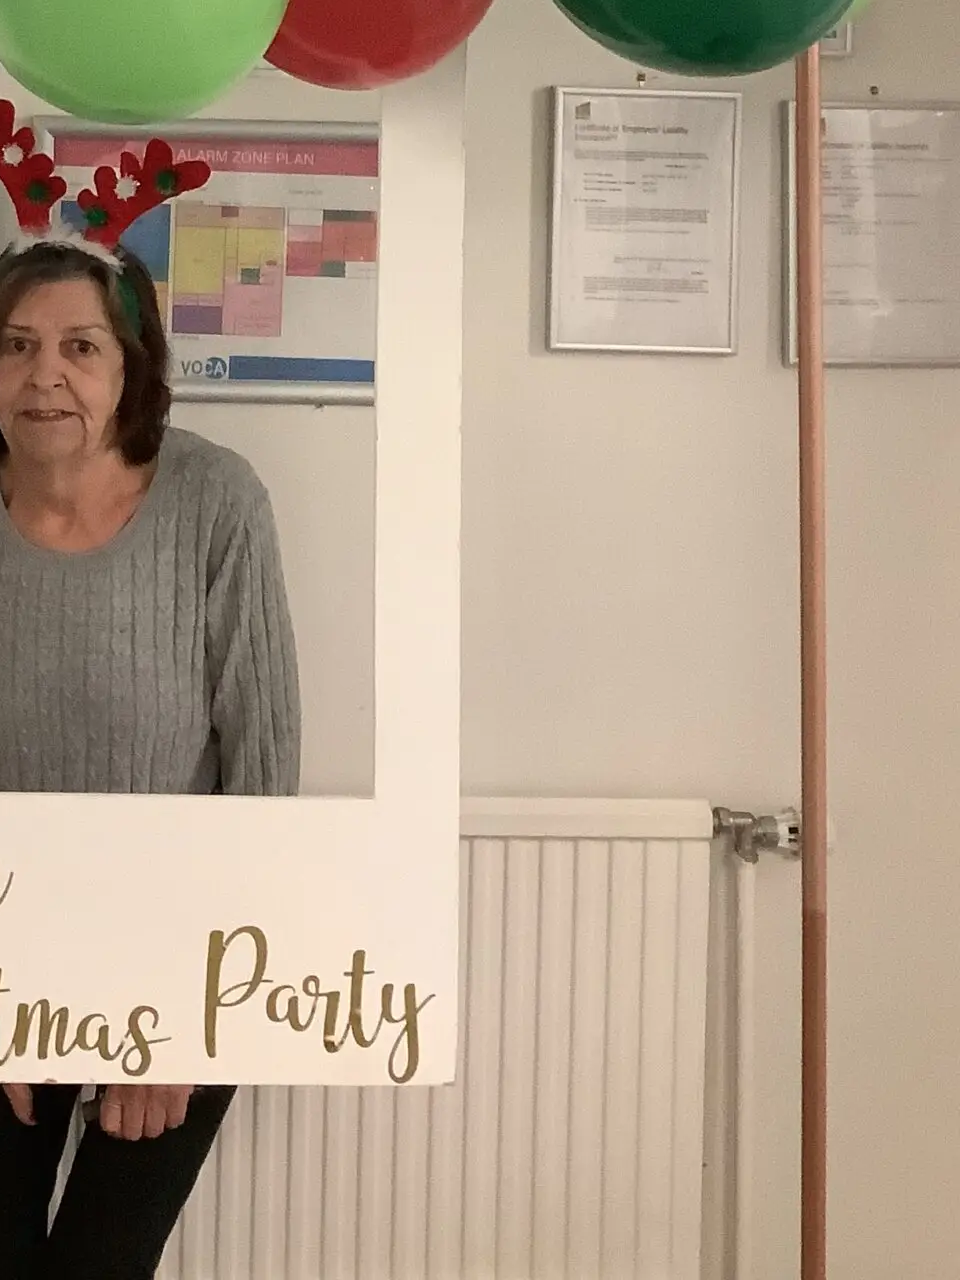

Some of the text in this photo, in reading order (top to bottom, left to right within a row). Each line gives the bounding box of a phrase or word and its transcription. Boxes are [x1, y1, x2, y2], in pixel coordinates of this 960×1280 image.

[176, 148, 228, 165] ALARM
[231, 150, 273, 165] ZONE
[276, 150, 315, 166] PLAN
[204, 925, 436, 1084] Party
